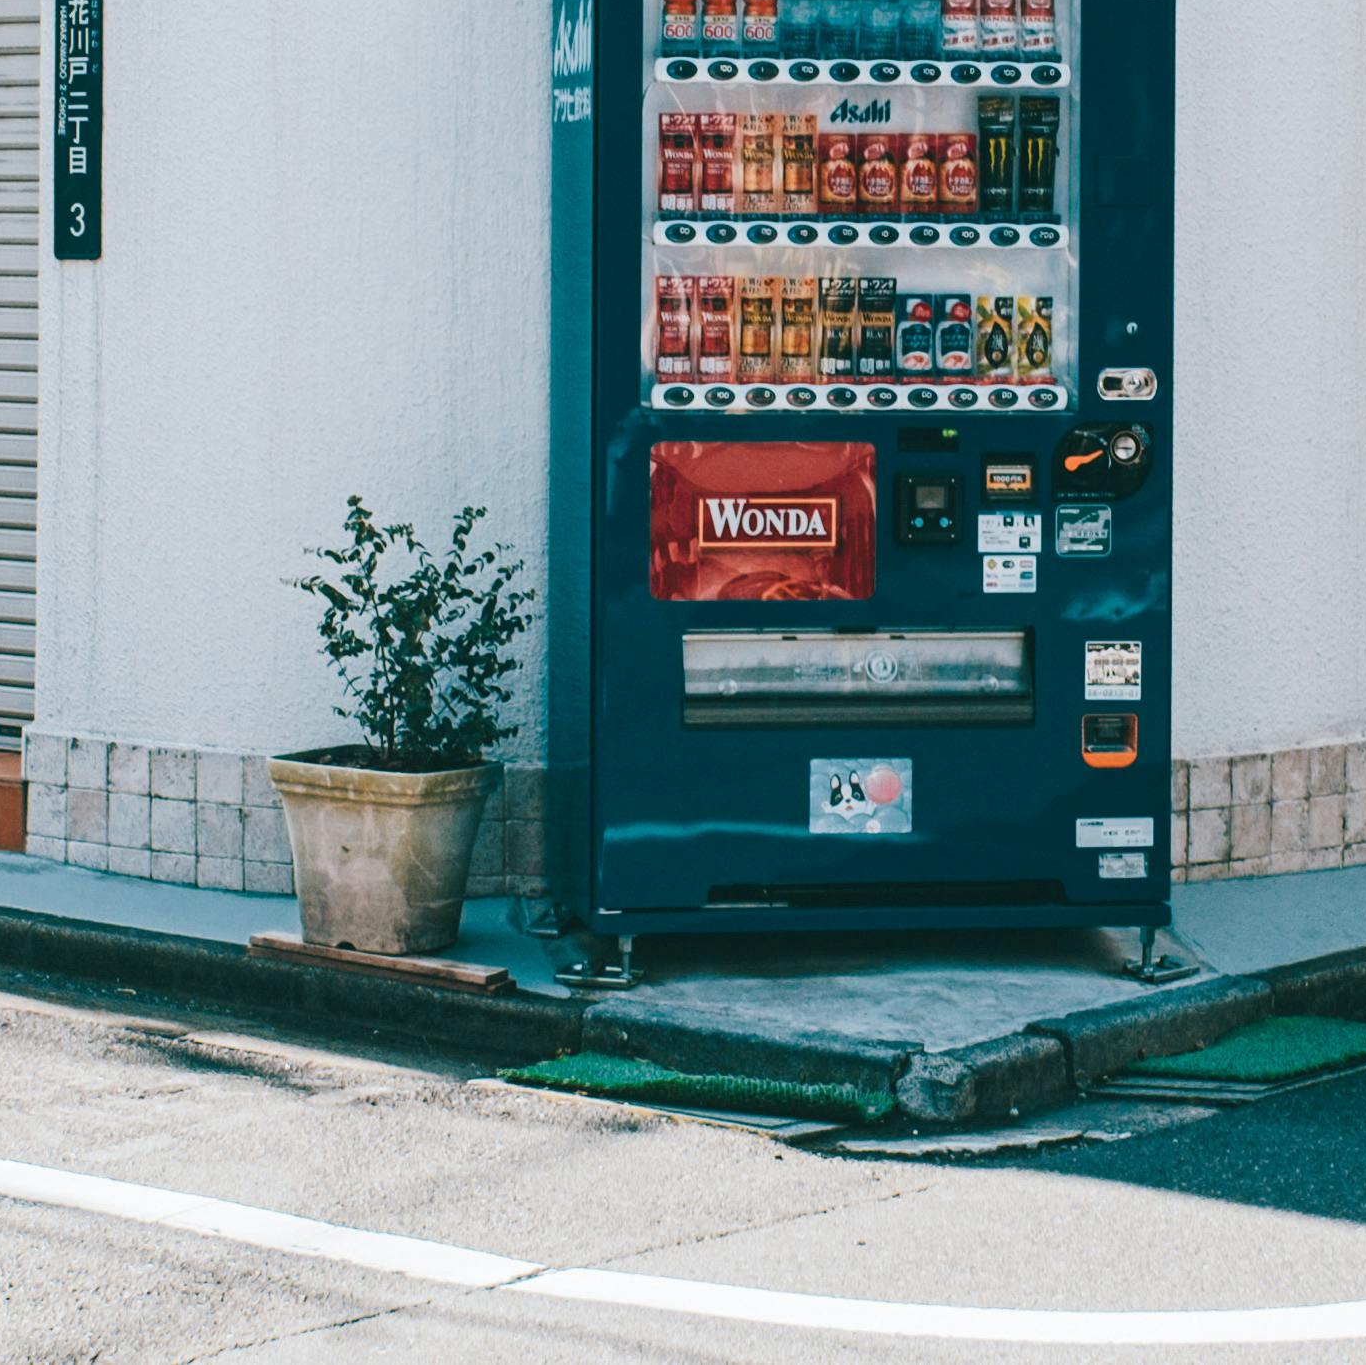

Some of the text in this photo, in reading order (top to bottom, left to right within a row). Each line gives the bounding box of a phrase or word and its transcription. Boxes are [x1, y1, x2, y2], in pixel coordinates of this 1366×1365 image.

[665, 25, 693, 38] 600
[704, 25, 733, 38] 600
[745, 26, 774, 39] 600
[830, 98, 891, 124] Asahi
[69, 202, 86, 237] 3
[706, 498, 827, 538] WONDA
